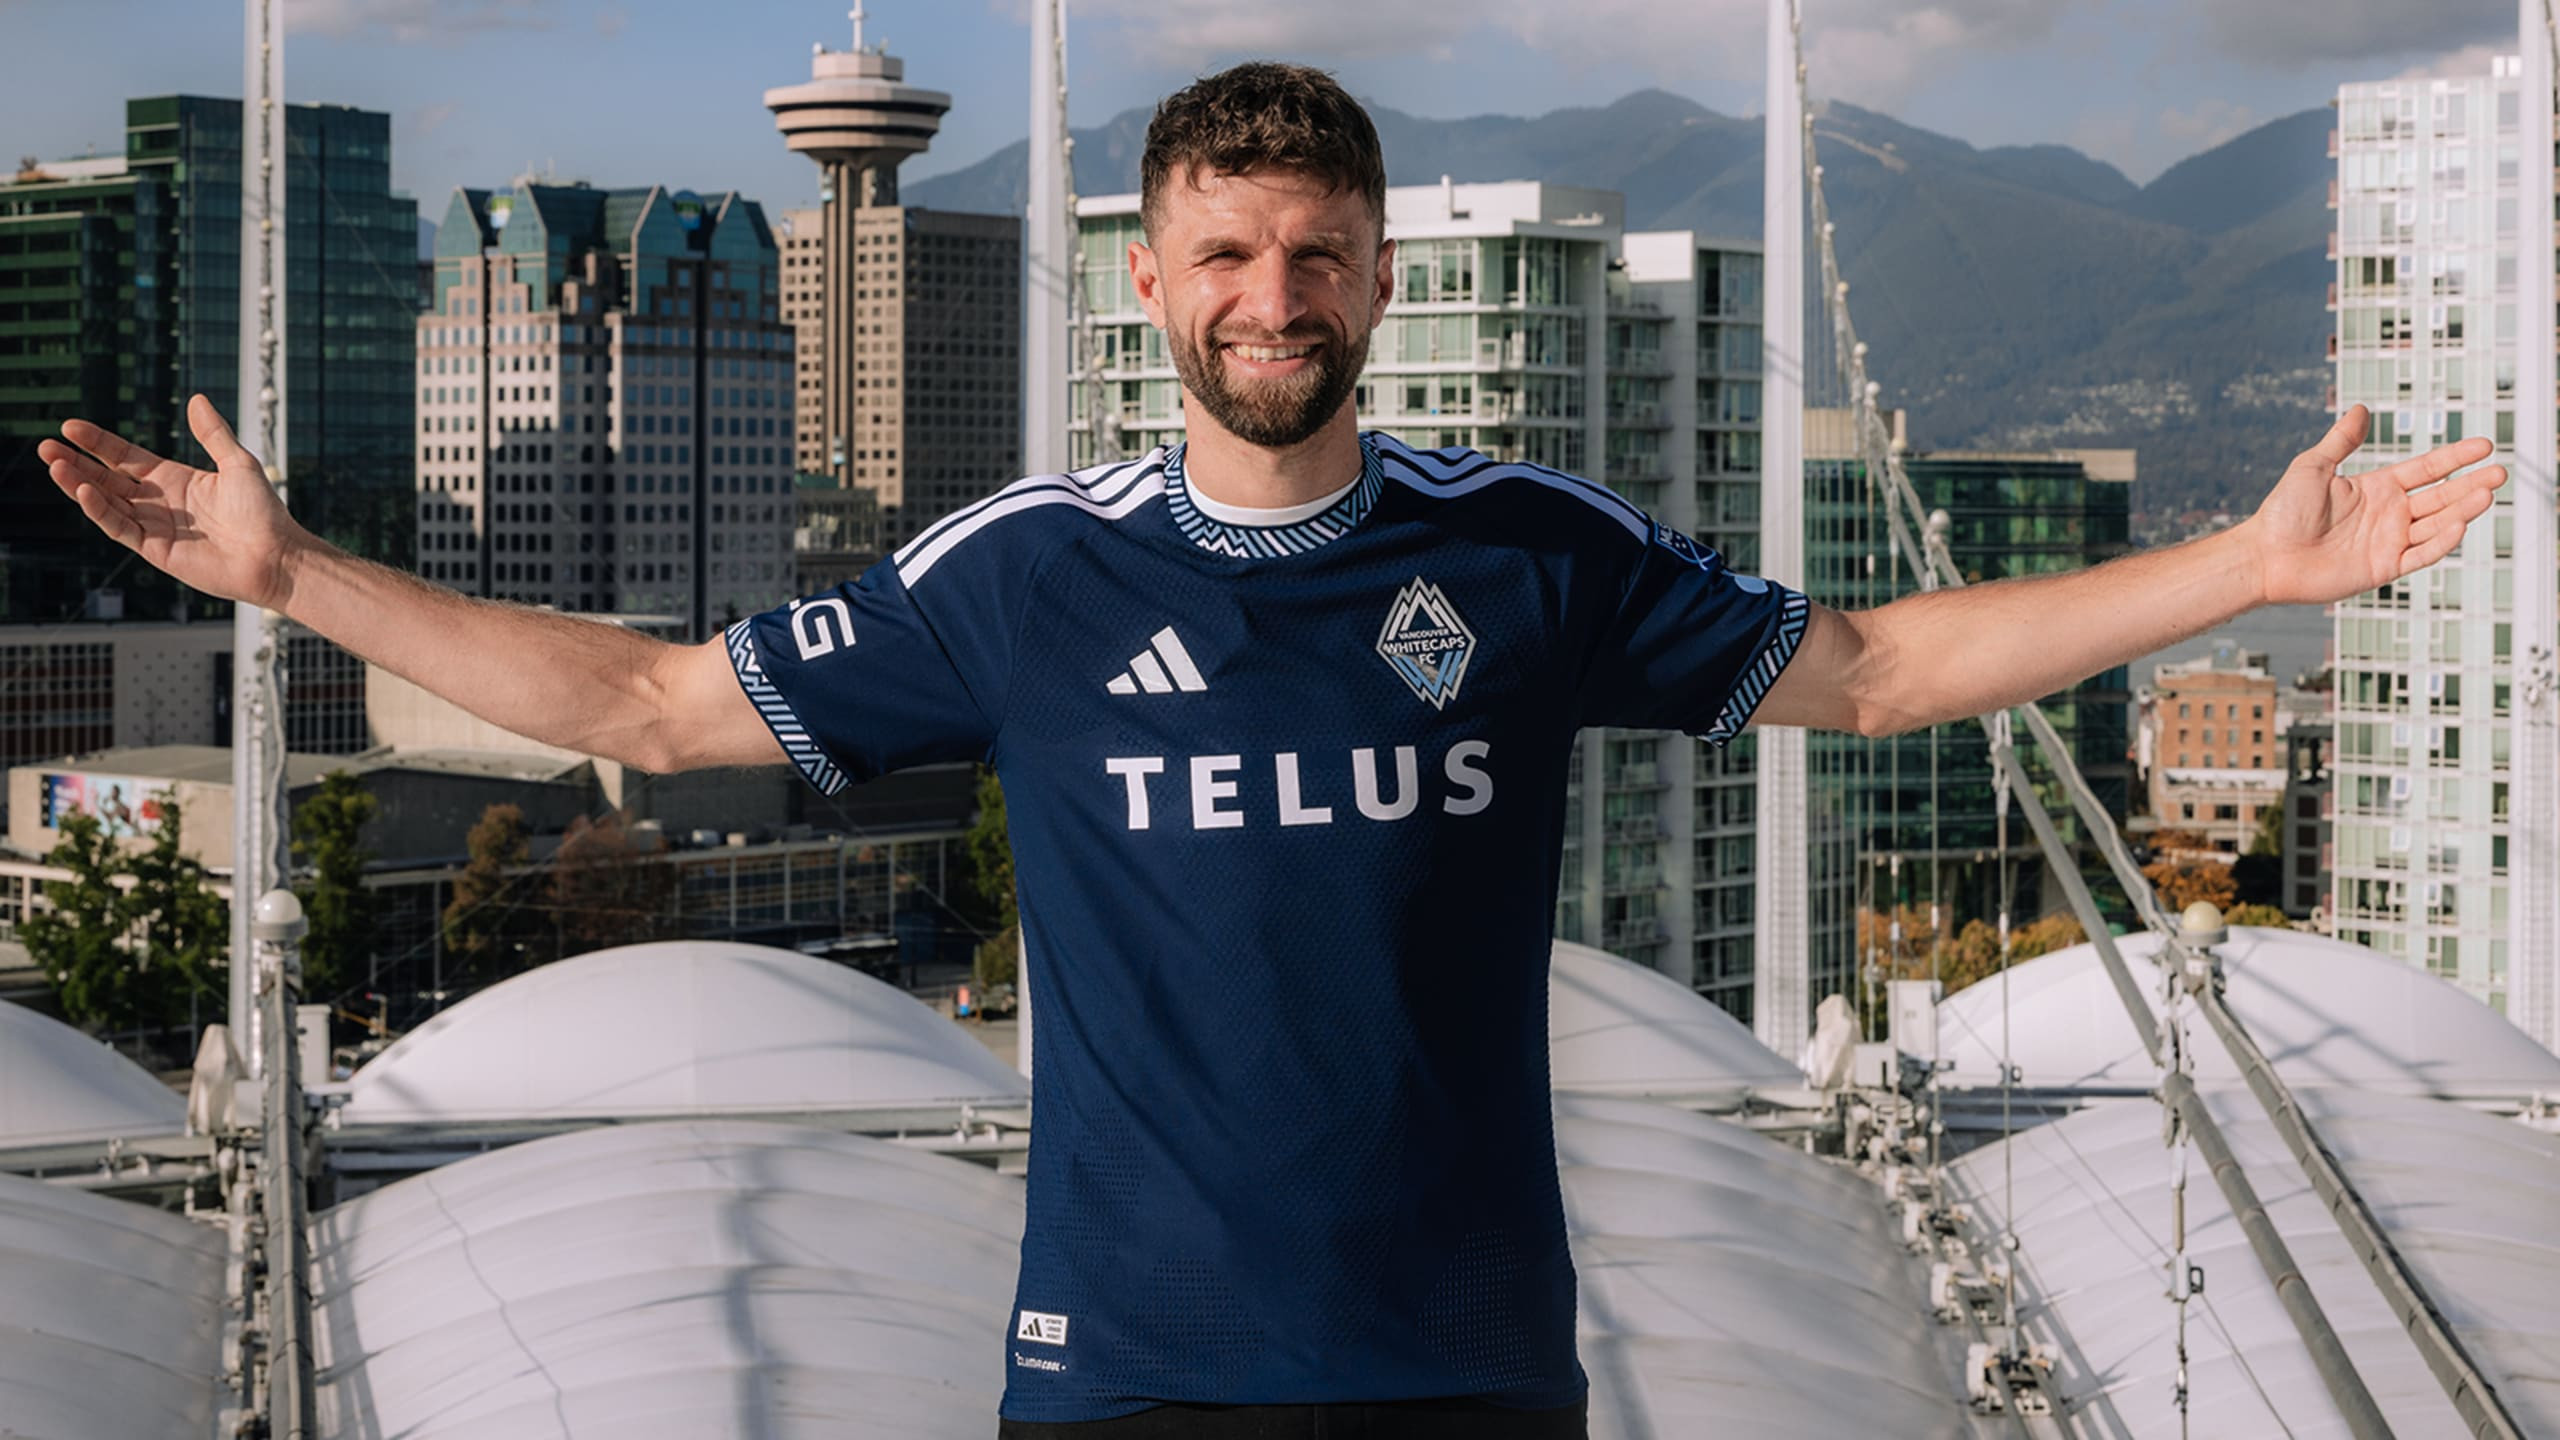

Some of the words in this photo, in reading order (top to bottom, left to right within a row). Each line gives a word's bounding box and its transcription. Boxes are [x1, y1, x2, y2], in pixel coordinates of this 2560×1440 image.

[1398, 628, 1449, 640] VANCOUVER
[1382, 636, 1466, 654] WHITECAPS
[1418, 652, 1436, 665] FC
[1105, 740, 1494, 830] TELUS
